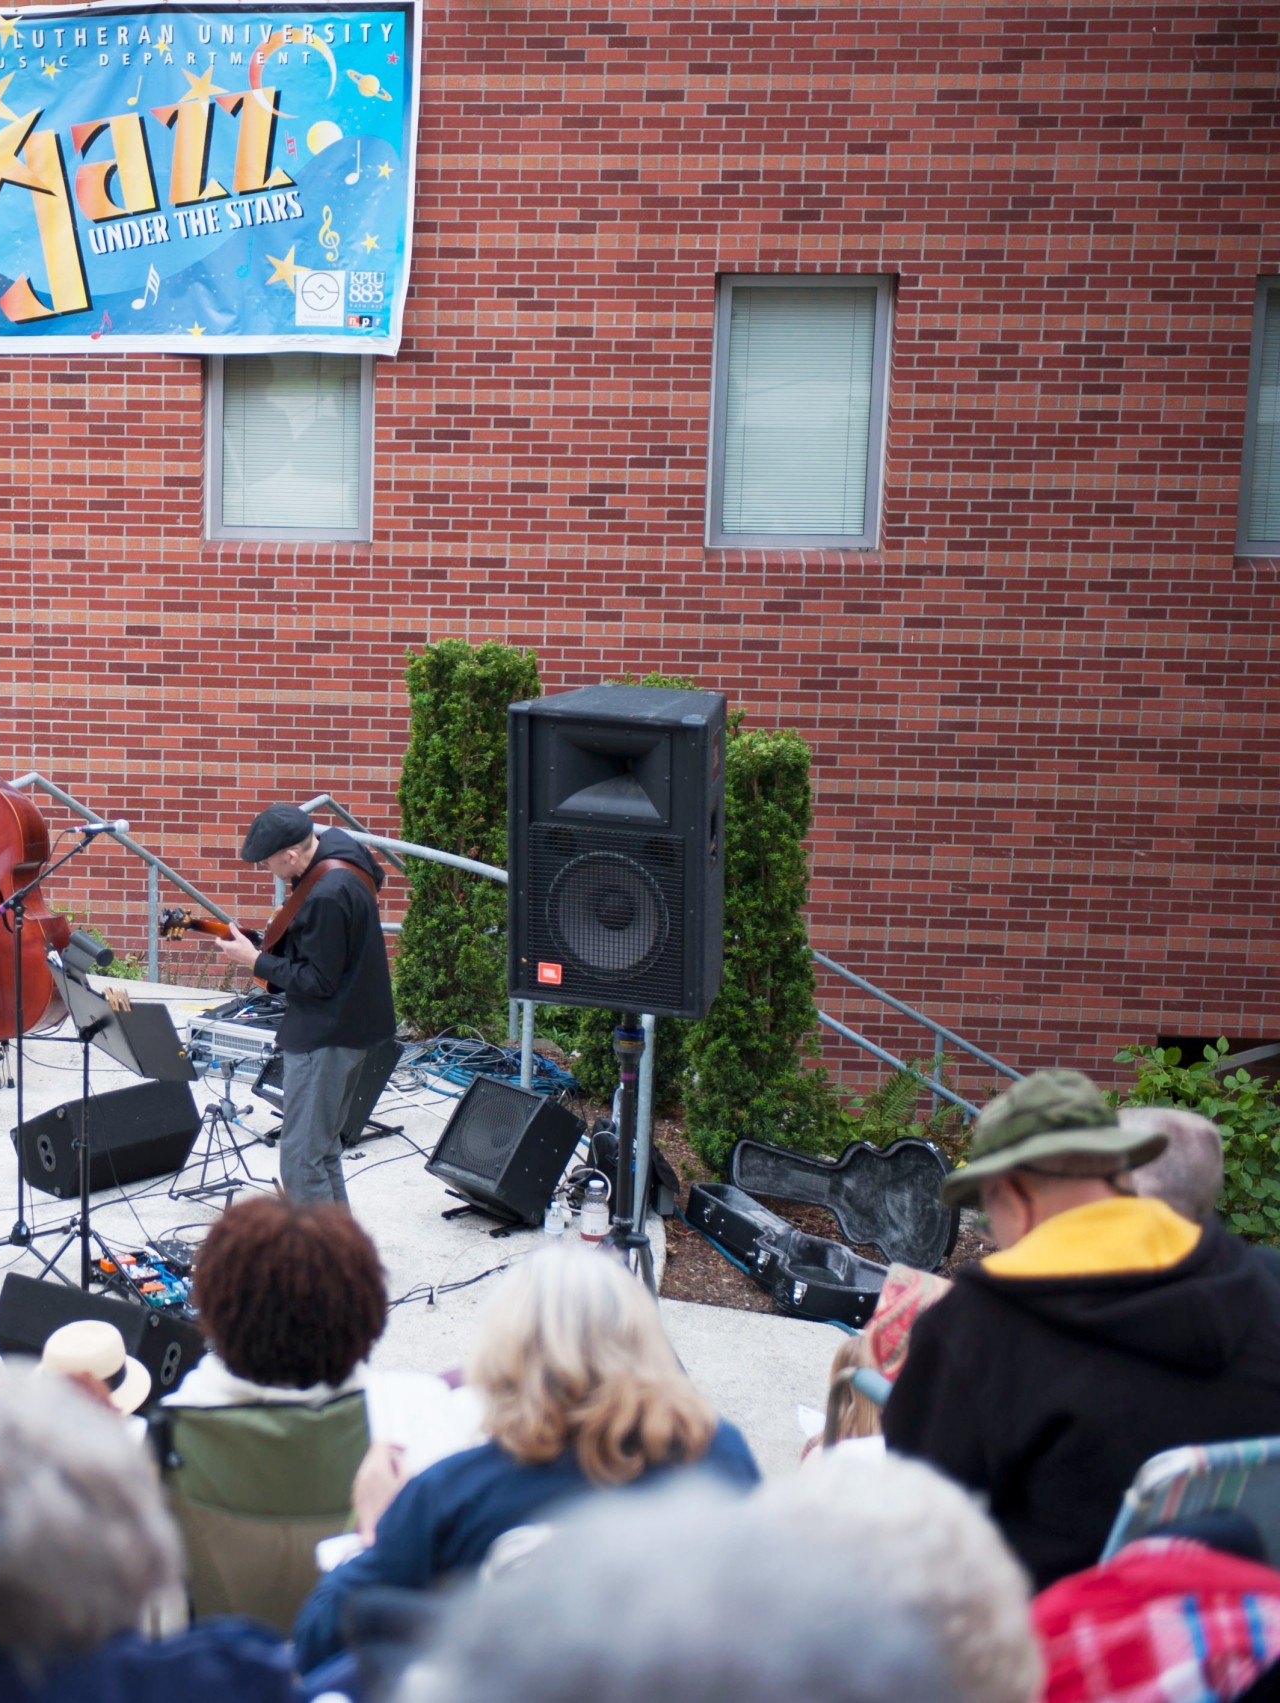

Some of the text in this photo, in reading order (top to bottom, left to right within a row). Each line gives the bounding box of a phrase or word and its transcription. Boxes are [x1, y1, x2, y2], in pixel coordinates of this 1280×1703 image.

[13, 24, 173, 49] LUTHERAN
[198, 23, 393, 45] UNIVERSITY
[99, 51, 311, 67] DEPARTMENT
[88, 190, 304, 255] UNDER THE STARS
